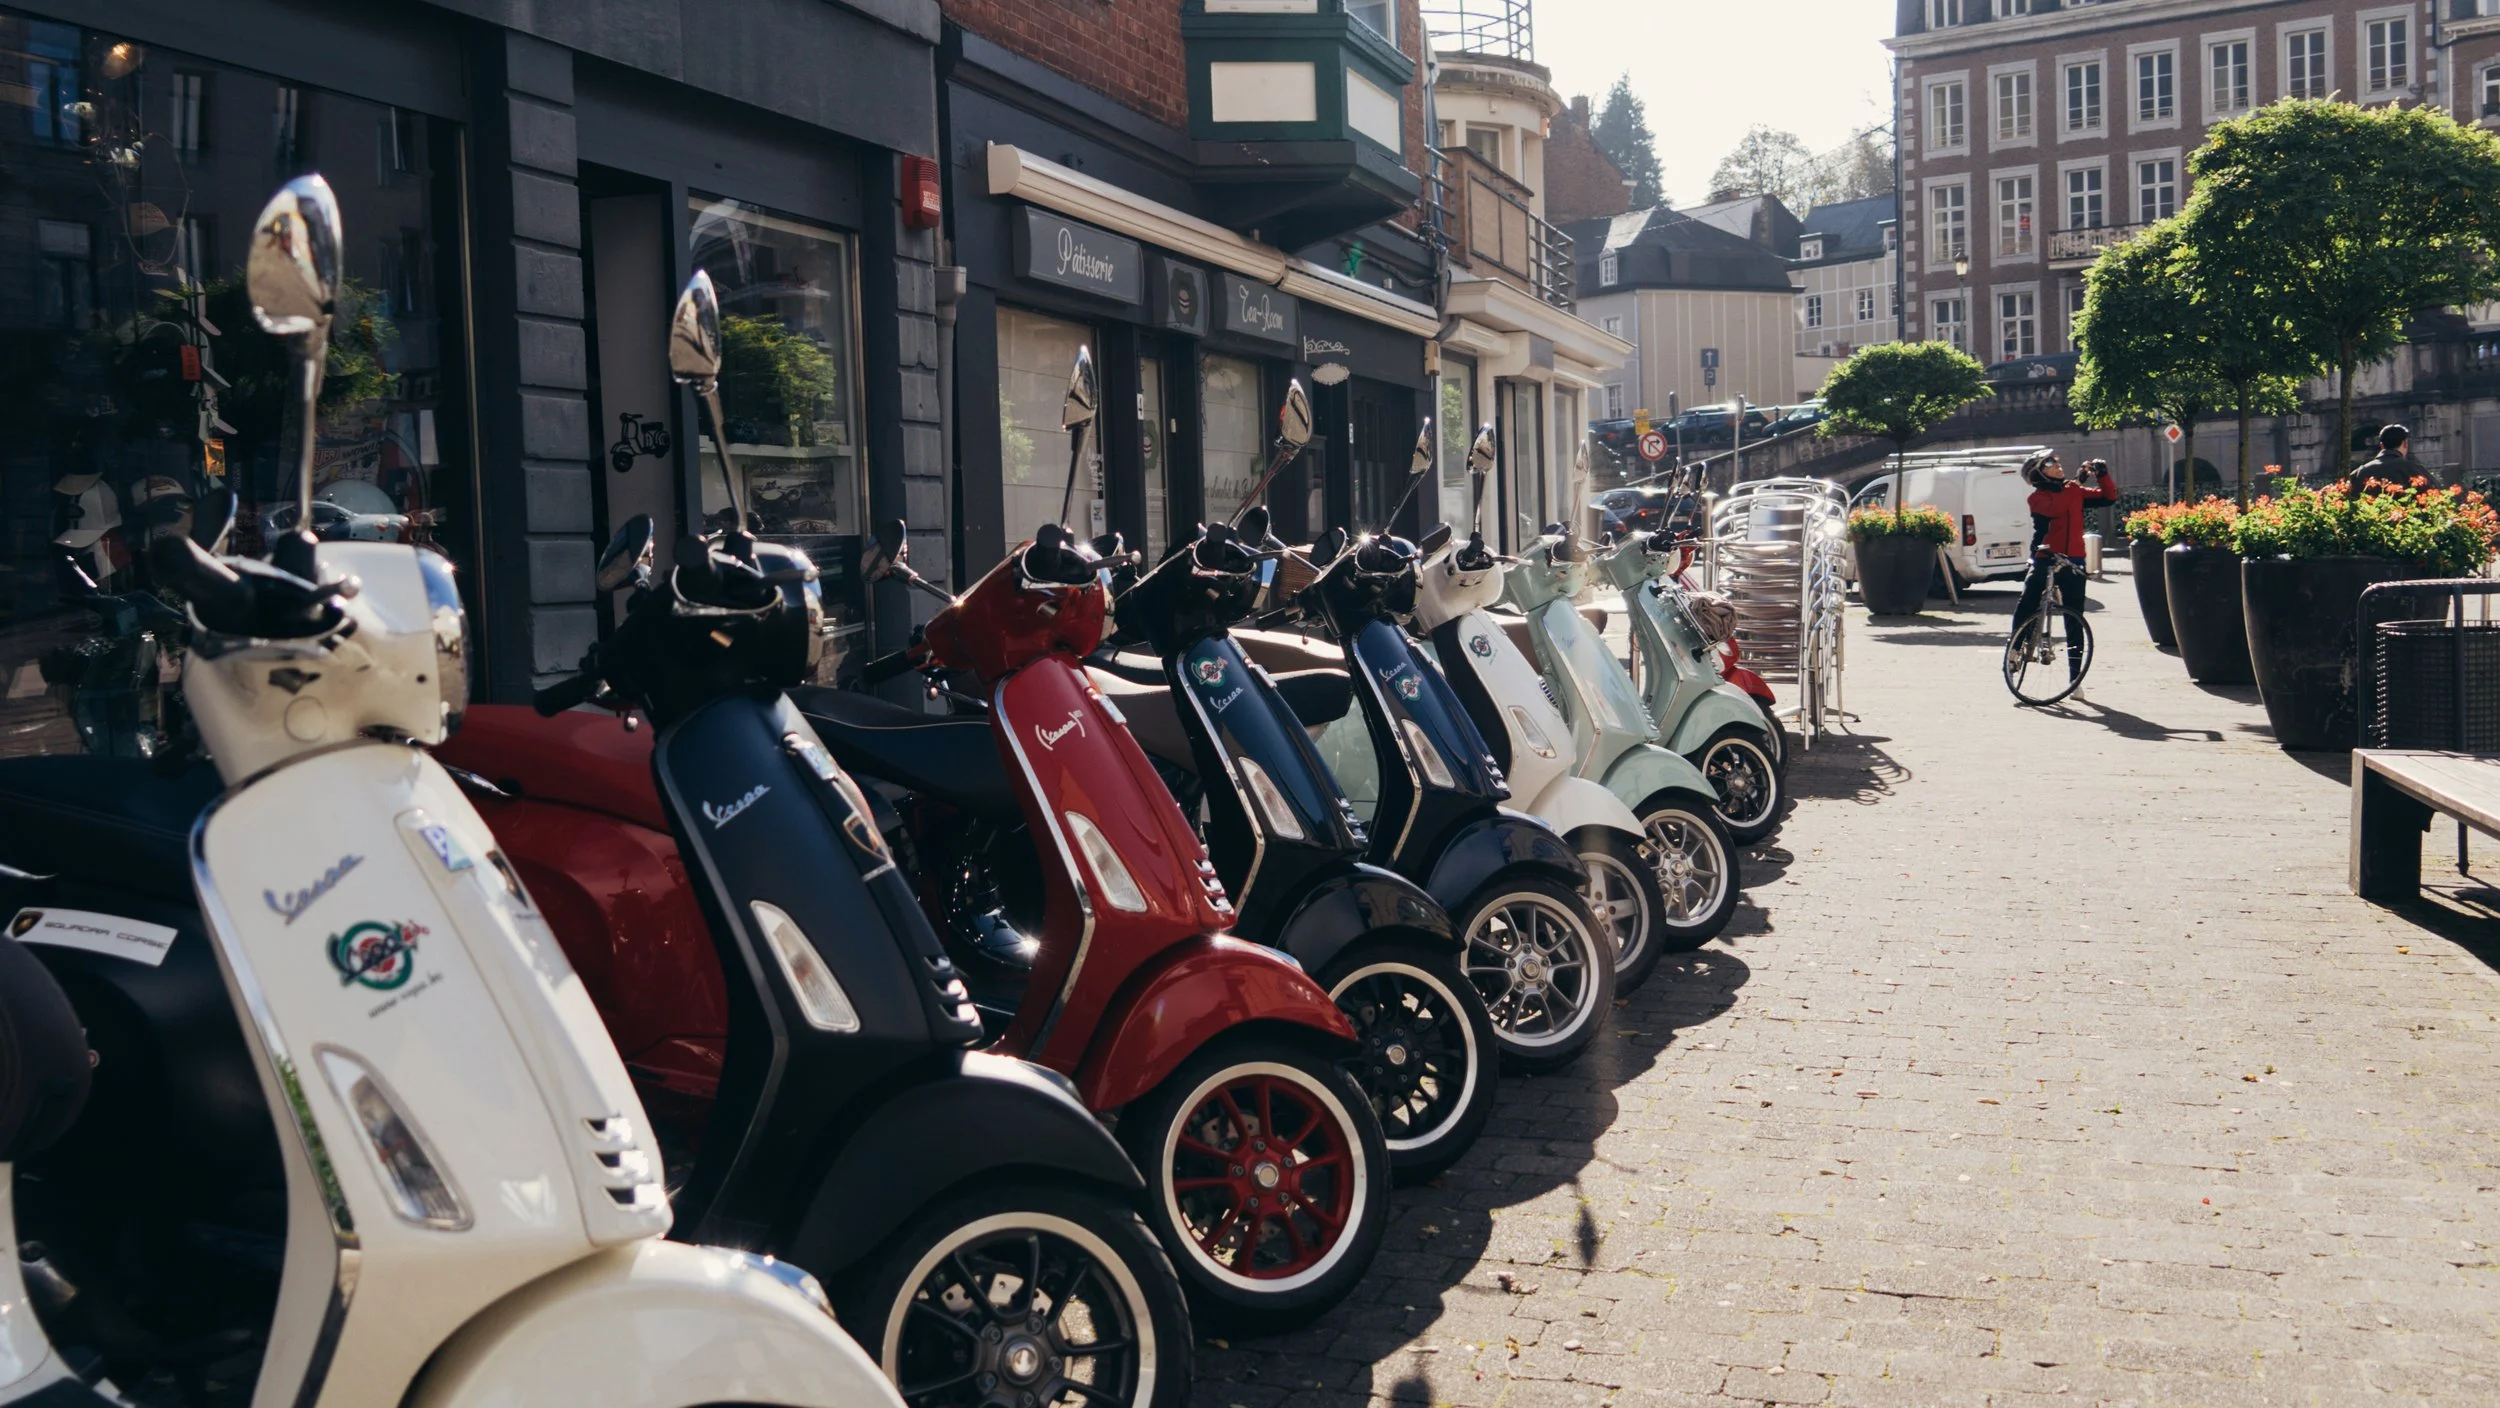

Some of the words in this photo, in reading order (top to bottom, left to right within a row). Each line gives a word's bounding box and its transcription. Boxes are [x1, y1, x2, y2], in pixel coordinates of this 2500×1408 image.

[1056, 227, 1115, 283] Pâtisserie
[1238, 284, 1284, 333] Tea-Room
[1379, 662, 1407, 682] Vespa
[1209, 687, 1245, 714] Vespa
[702, 784, 771, 830] Vespa
[262, 855, 366, 927] Vespa
[44, 921, 111, 936] SQUADRA
[116, 932, 169, 949] CORSE
